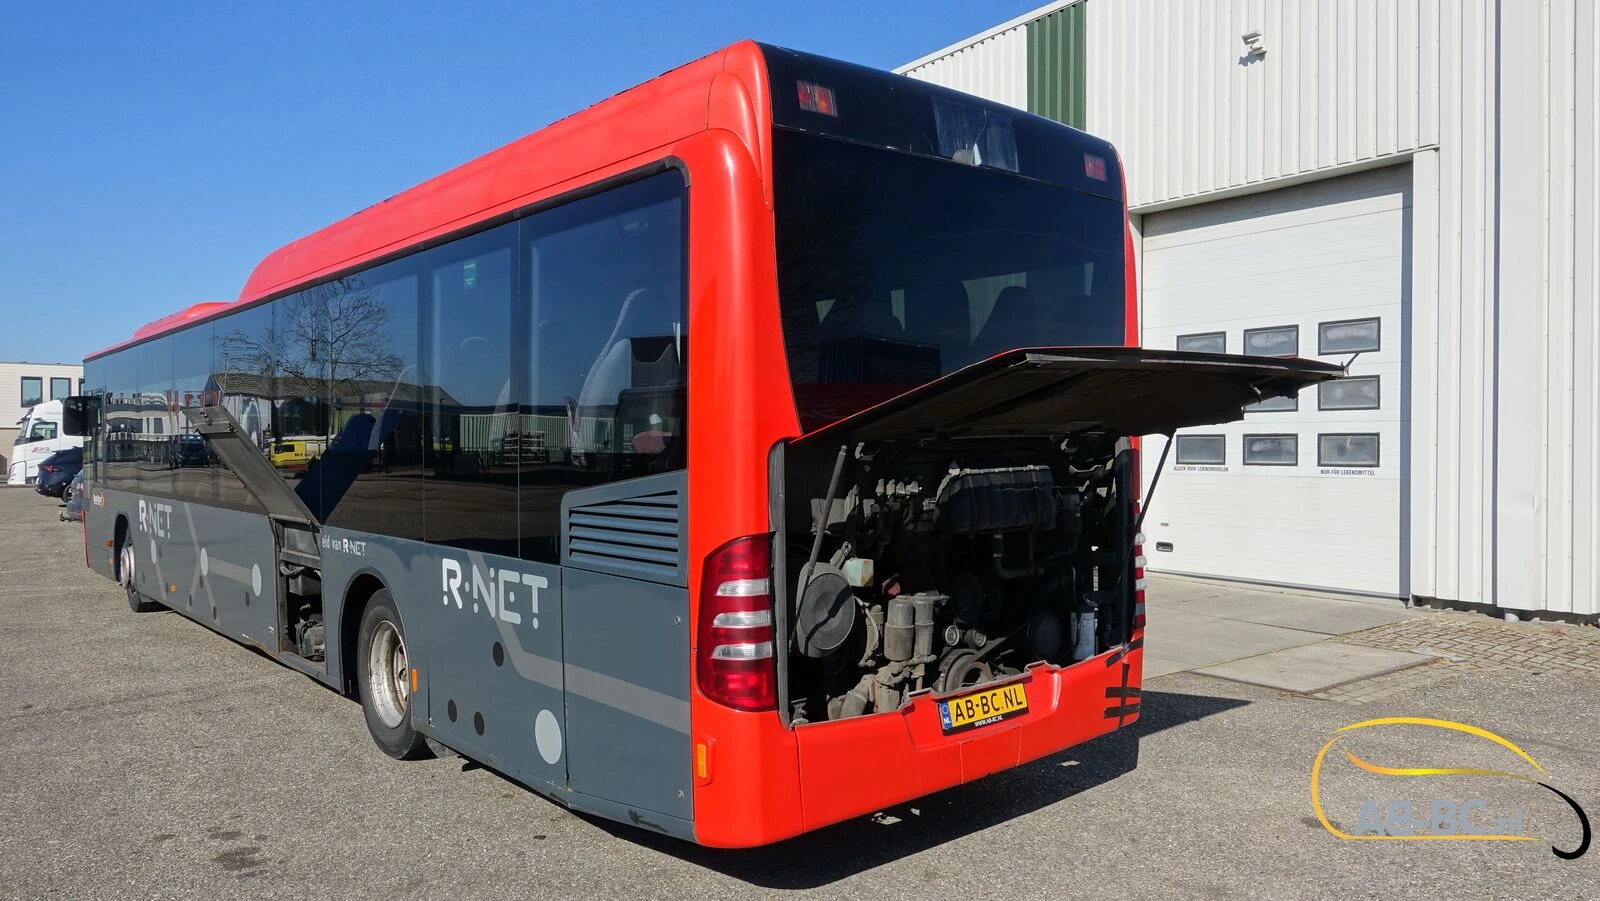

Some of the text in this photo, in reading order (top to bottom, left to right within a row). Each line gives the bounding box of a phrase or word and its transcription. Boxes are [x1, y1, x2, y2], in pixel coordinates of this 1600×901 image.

[331, 539, 342, 551] van
[955, 687, 1023, 722] AB-BC.NL
[944, 717, 952, 725] NL
